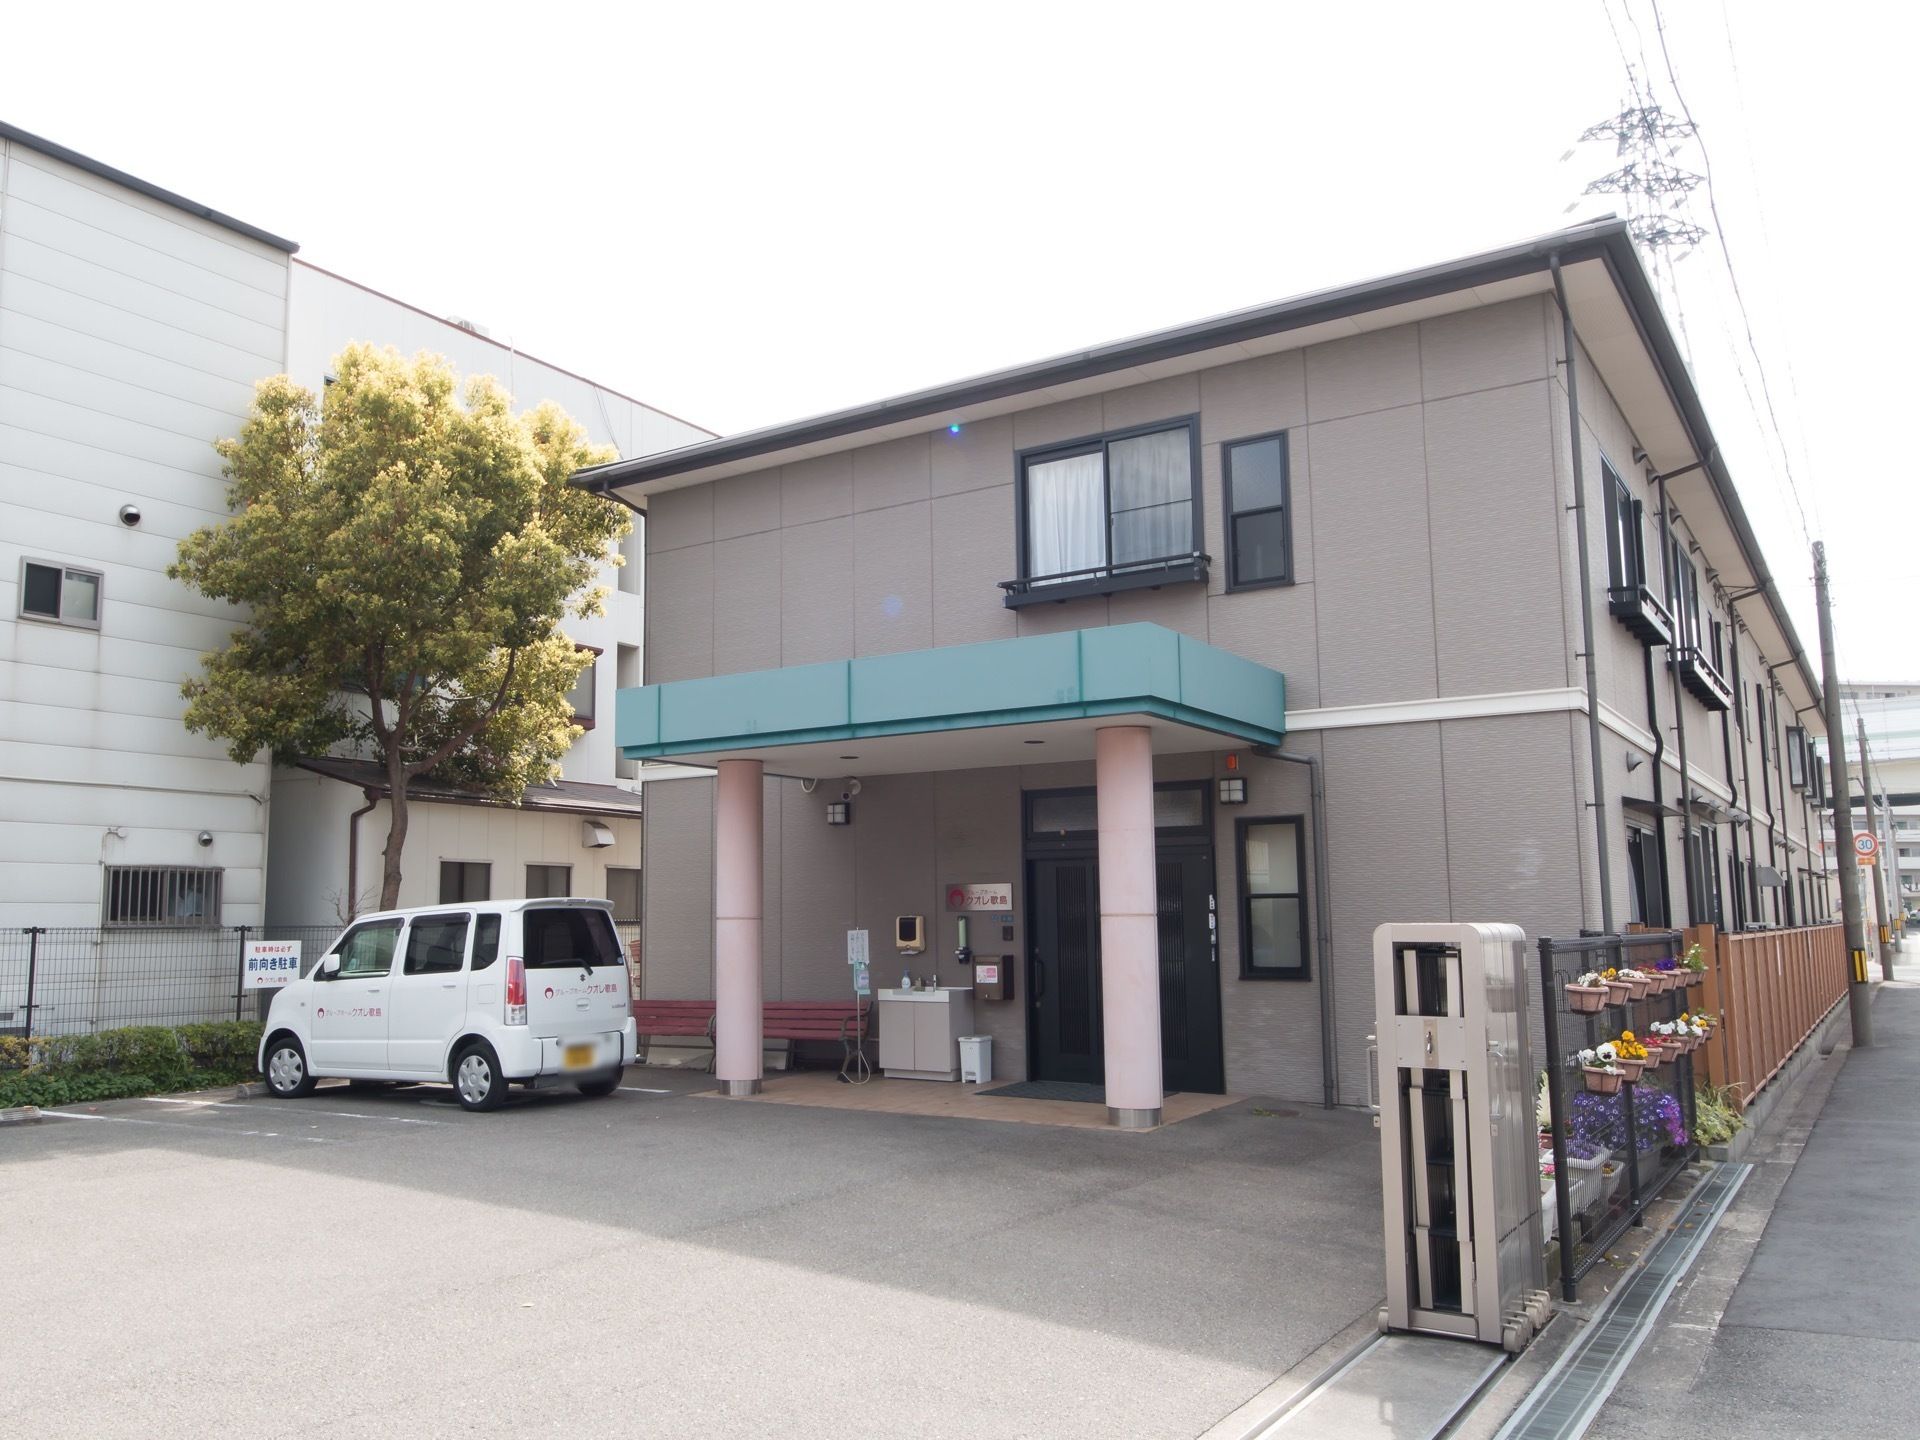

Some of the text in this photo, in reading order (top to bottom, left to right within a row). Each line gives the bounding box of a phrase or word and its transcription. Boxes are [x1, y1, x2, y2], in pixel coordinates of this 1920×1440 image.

[1857, 839, 1873, 850] 30
[255, 945, 293, 953] 駐車時は必ず
[248, 956, 298, 971] 前向き駐車
